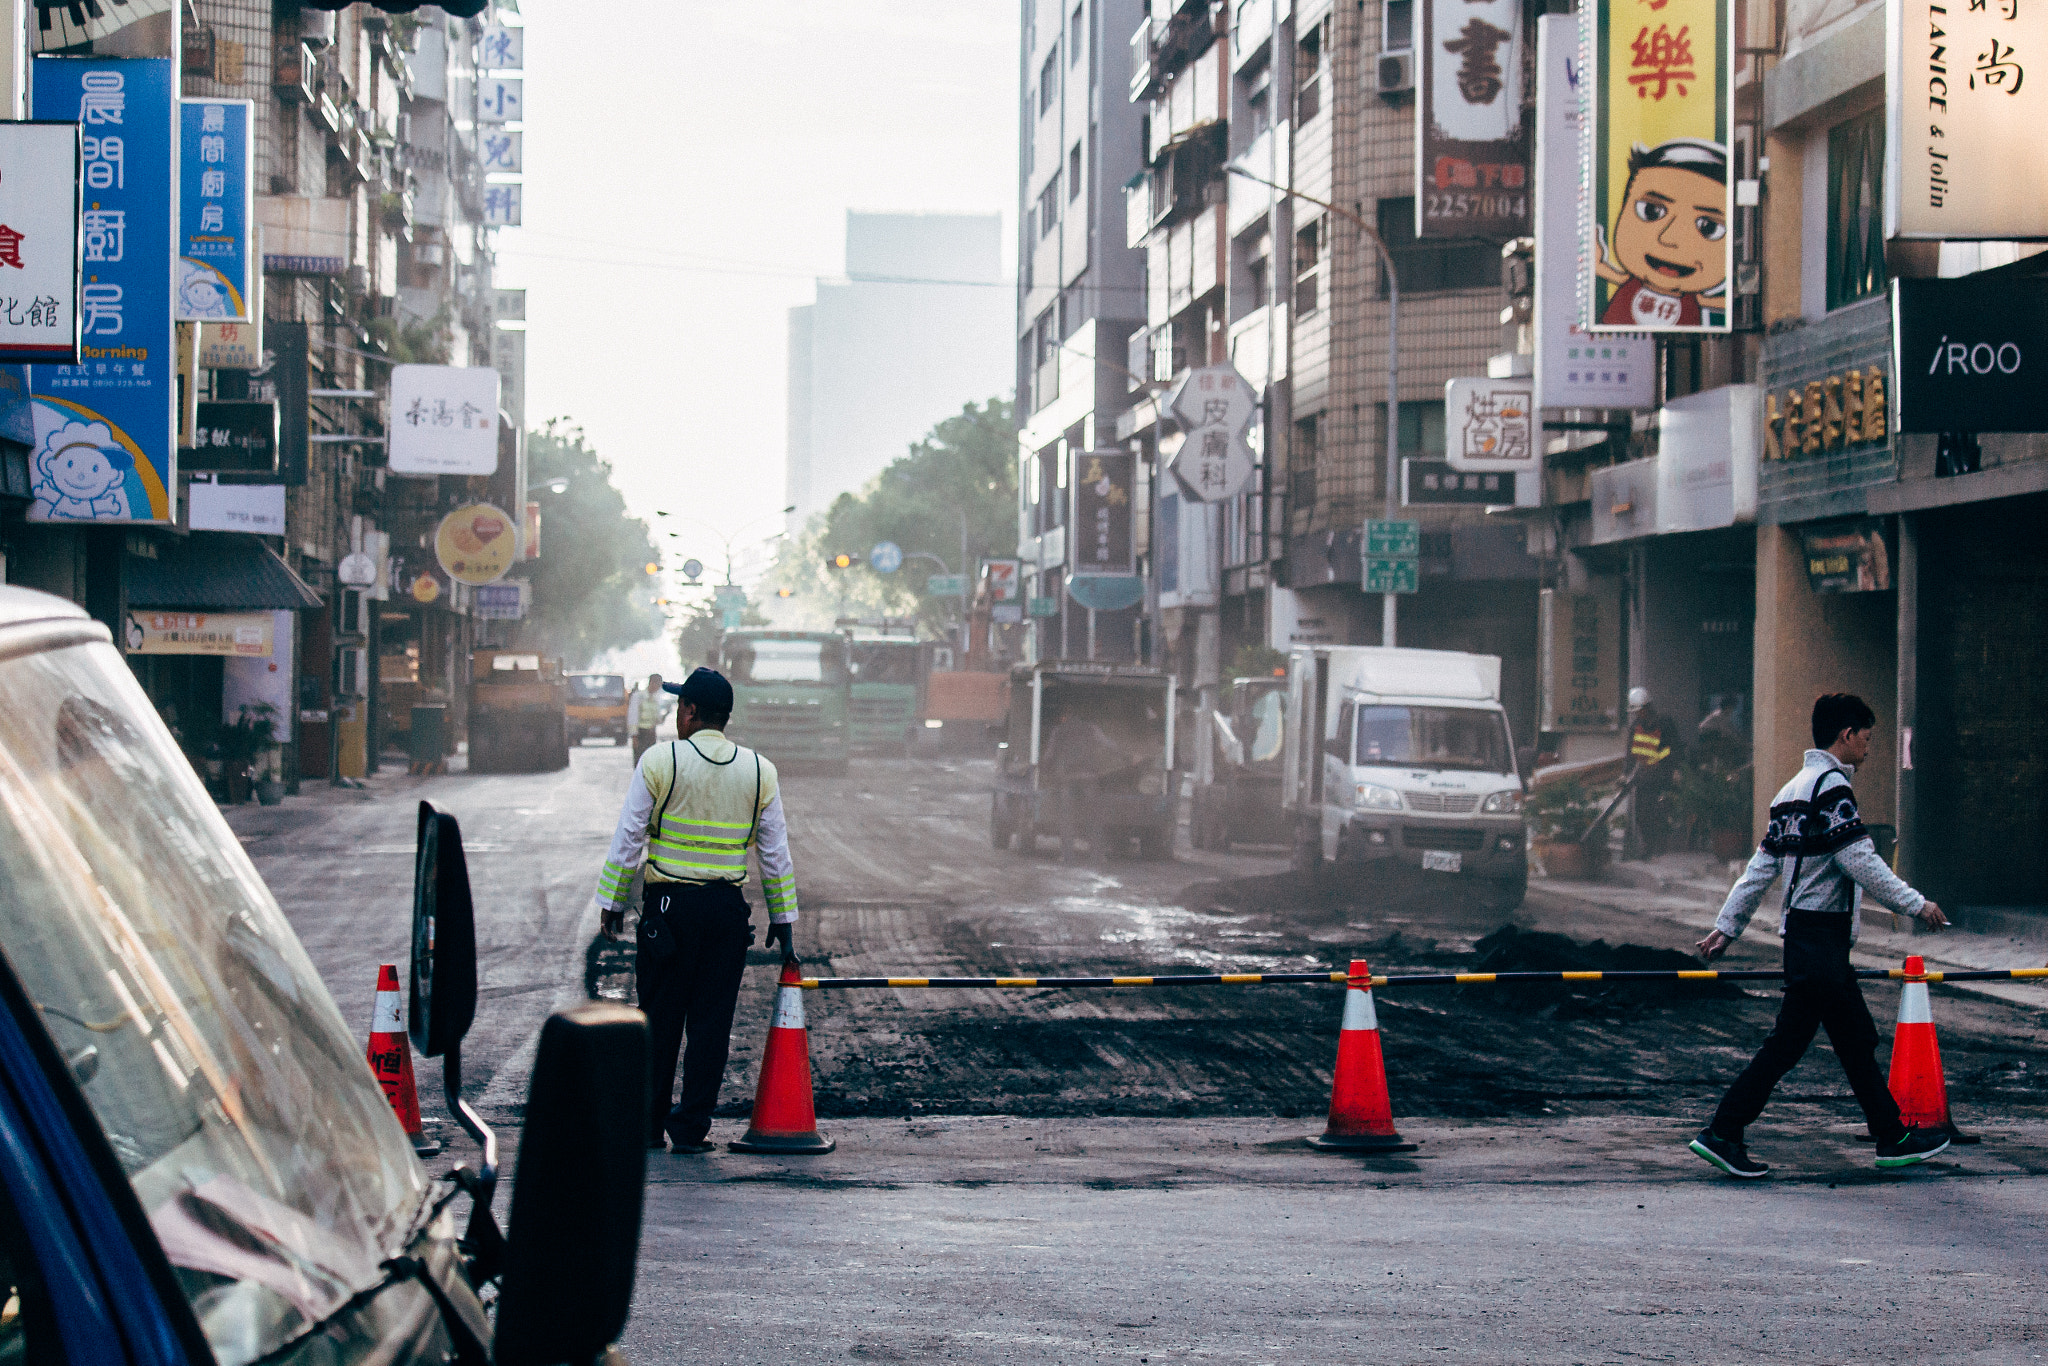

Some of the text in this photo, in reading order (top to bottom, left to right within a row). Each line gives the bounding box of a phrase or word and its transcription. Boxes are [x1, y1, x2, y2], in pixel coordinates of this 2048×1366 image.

[1443, 0, 1511, 104] 書
[1628, 0, 1697, 102] 樂
[1930, 125, 1945, 138] &
[1929, 147, 1949, 208] Jolin
[1929, 335, 2022, 376] iROO
